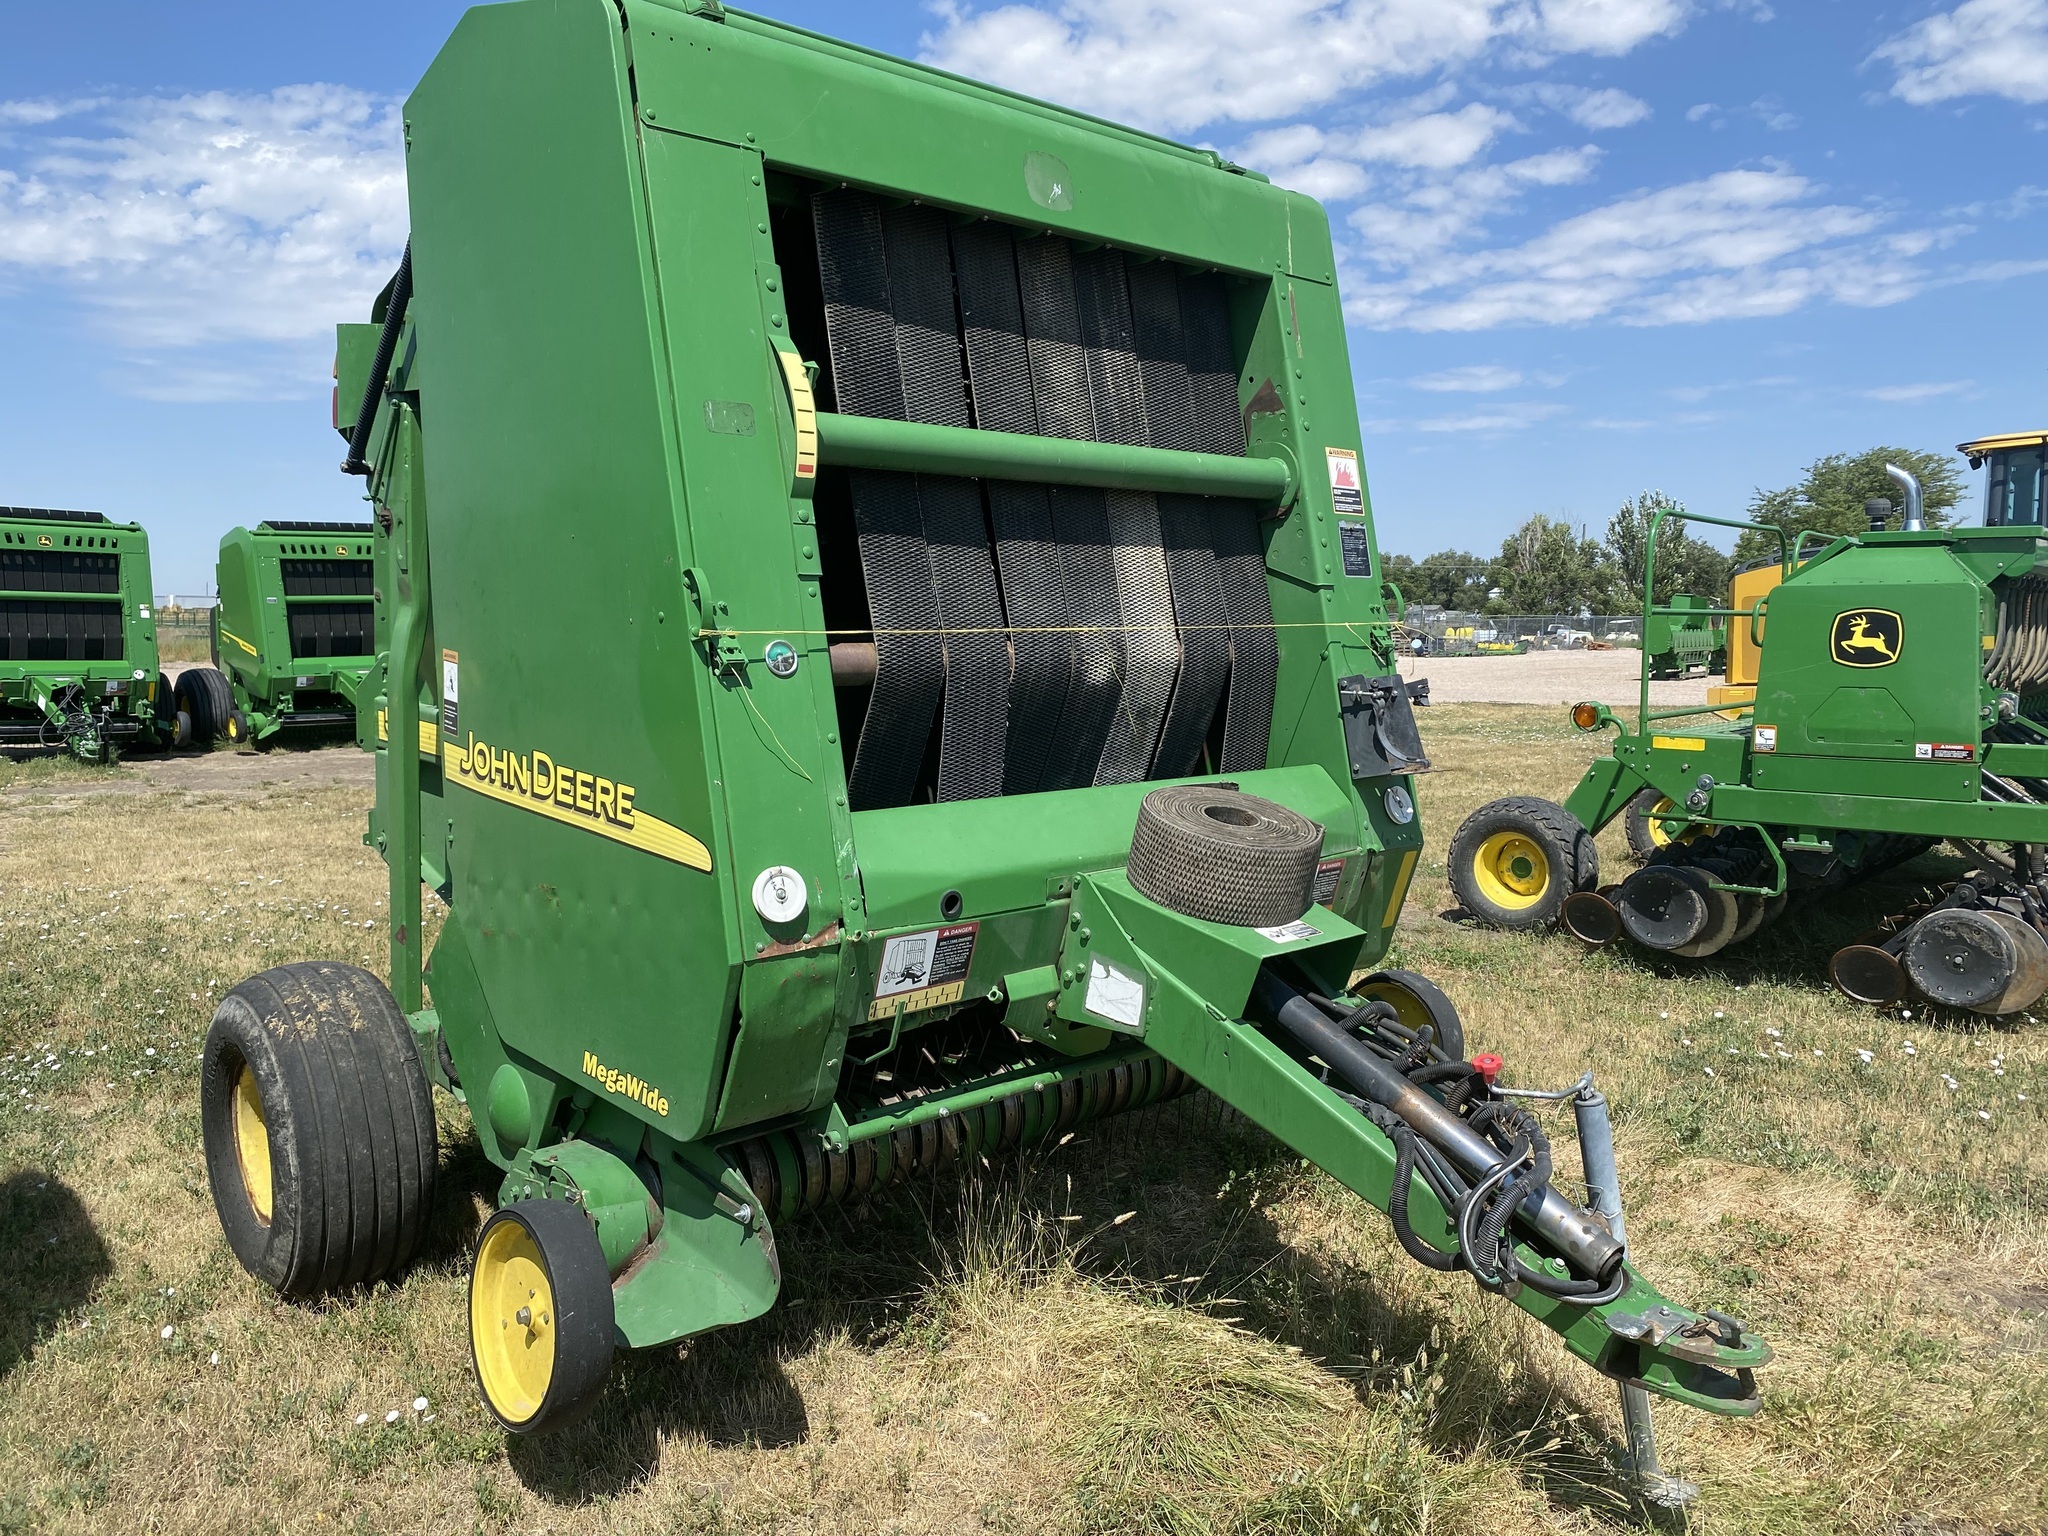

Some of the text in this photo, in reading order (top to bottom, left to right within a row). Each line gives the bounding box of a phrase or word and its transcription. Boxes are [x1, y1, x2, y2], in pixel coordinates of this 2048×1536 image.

[460, 730, 635, 830] JOHN DEERE
[950, 926, 972, 935] DANGER
[582, 1050, 669, 1116] MegaWide
